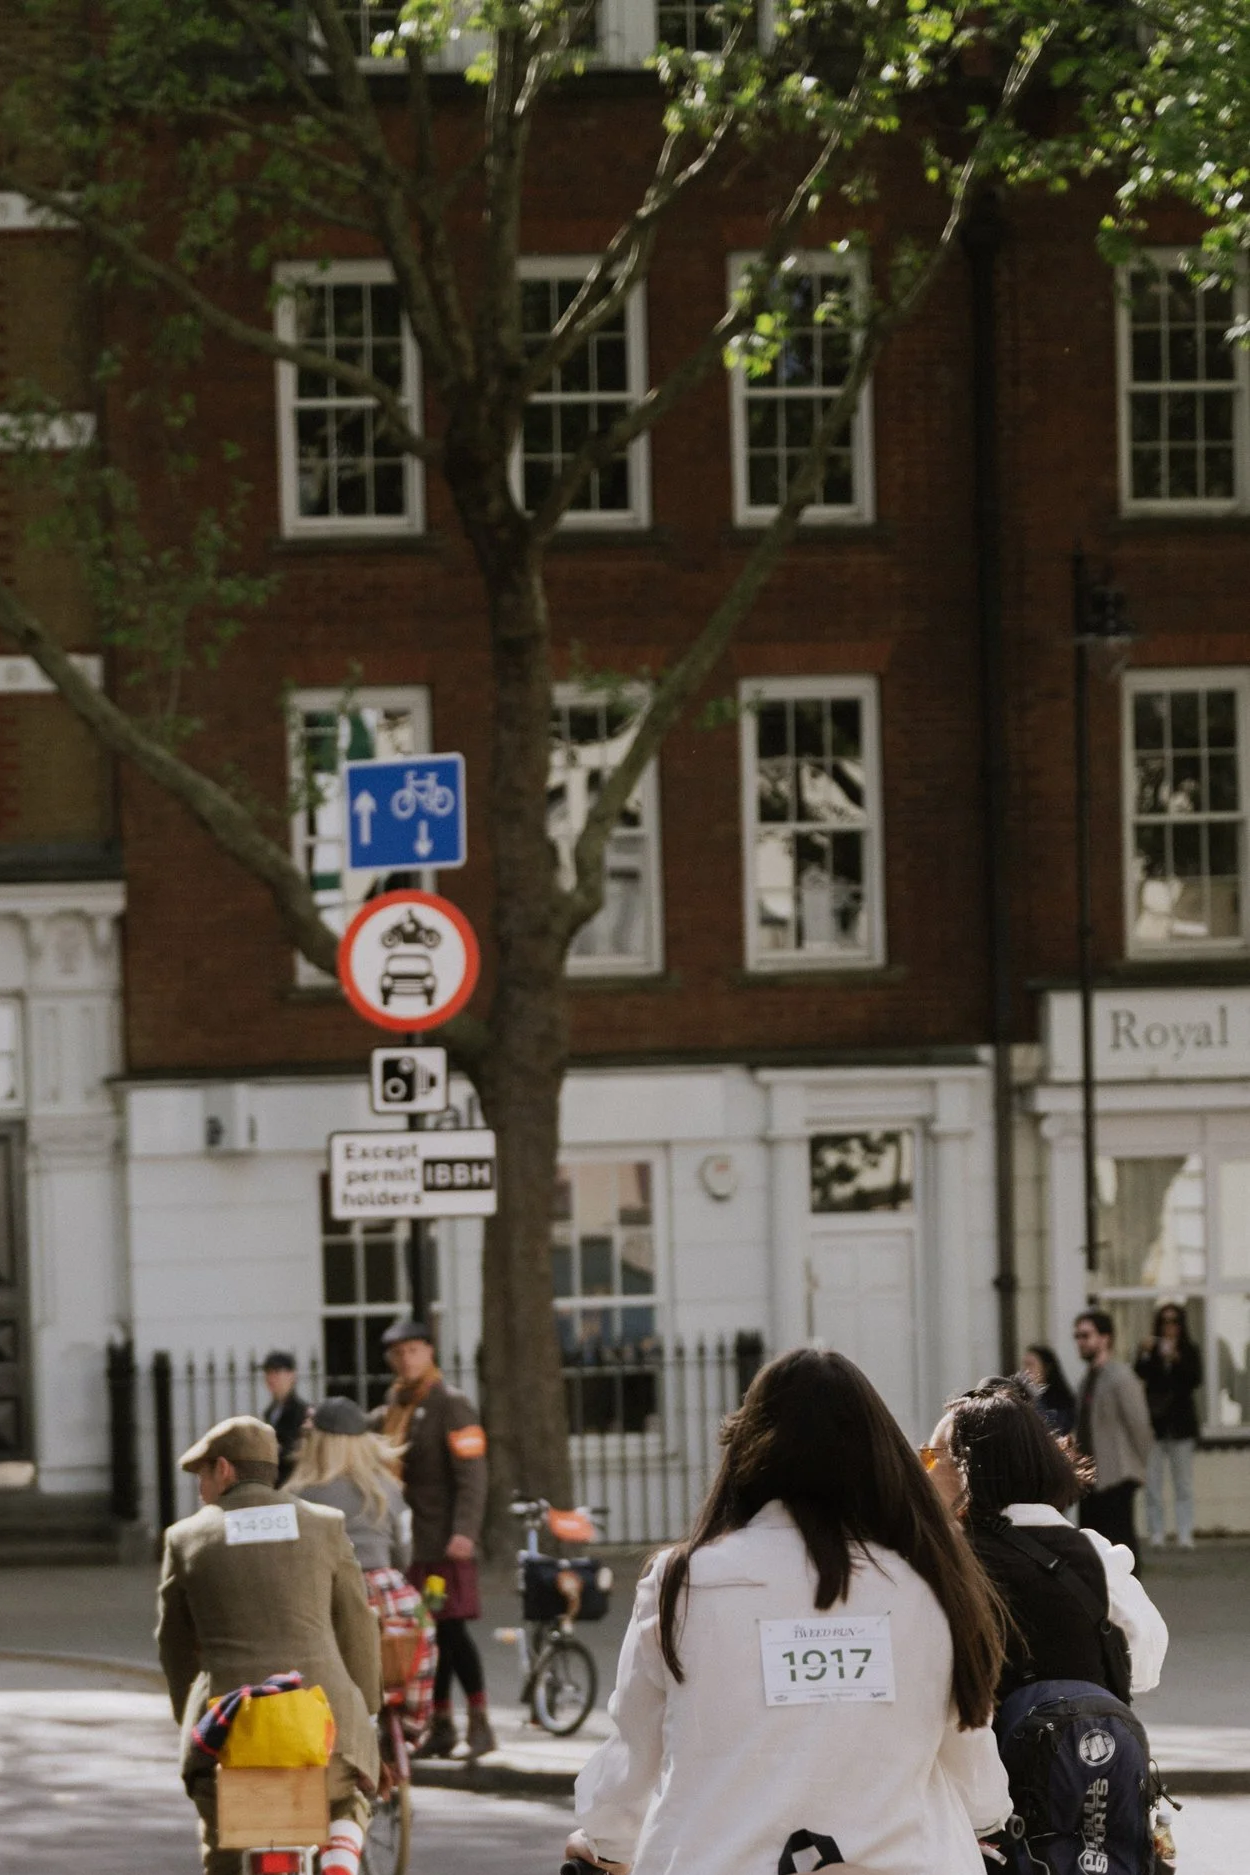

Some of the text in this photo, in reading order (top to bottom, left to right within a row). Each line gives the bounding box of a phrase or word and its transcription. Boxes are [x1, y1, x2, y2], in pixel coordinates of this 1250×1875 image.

[1110, 1005, 1229, 1061] Royal
[344, 1143, 418, 1161] Except
[346, 1168, 416, 1186] permit
[342, 1189, 422, 1206] holders
[782, 1648, 872, 1682] 1917
